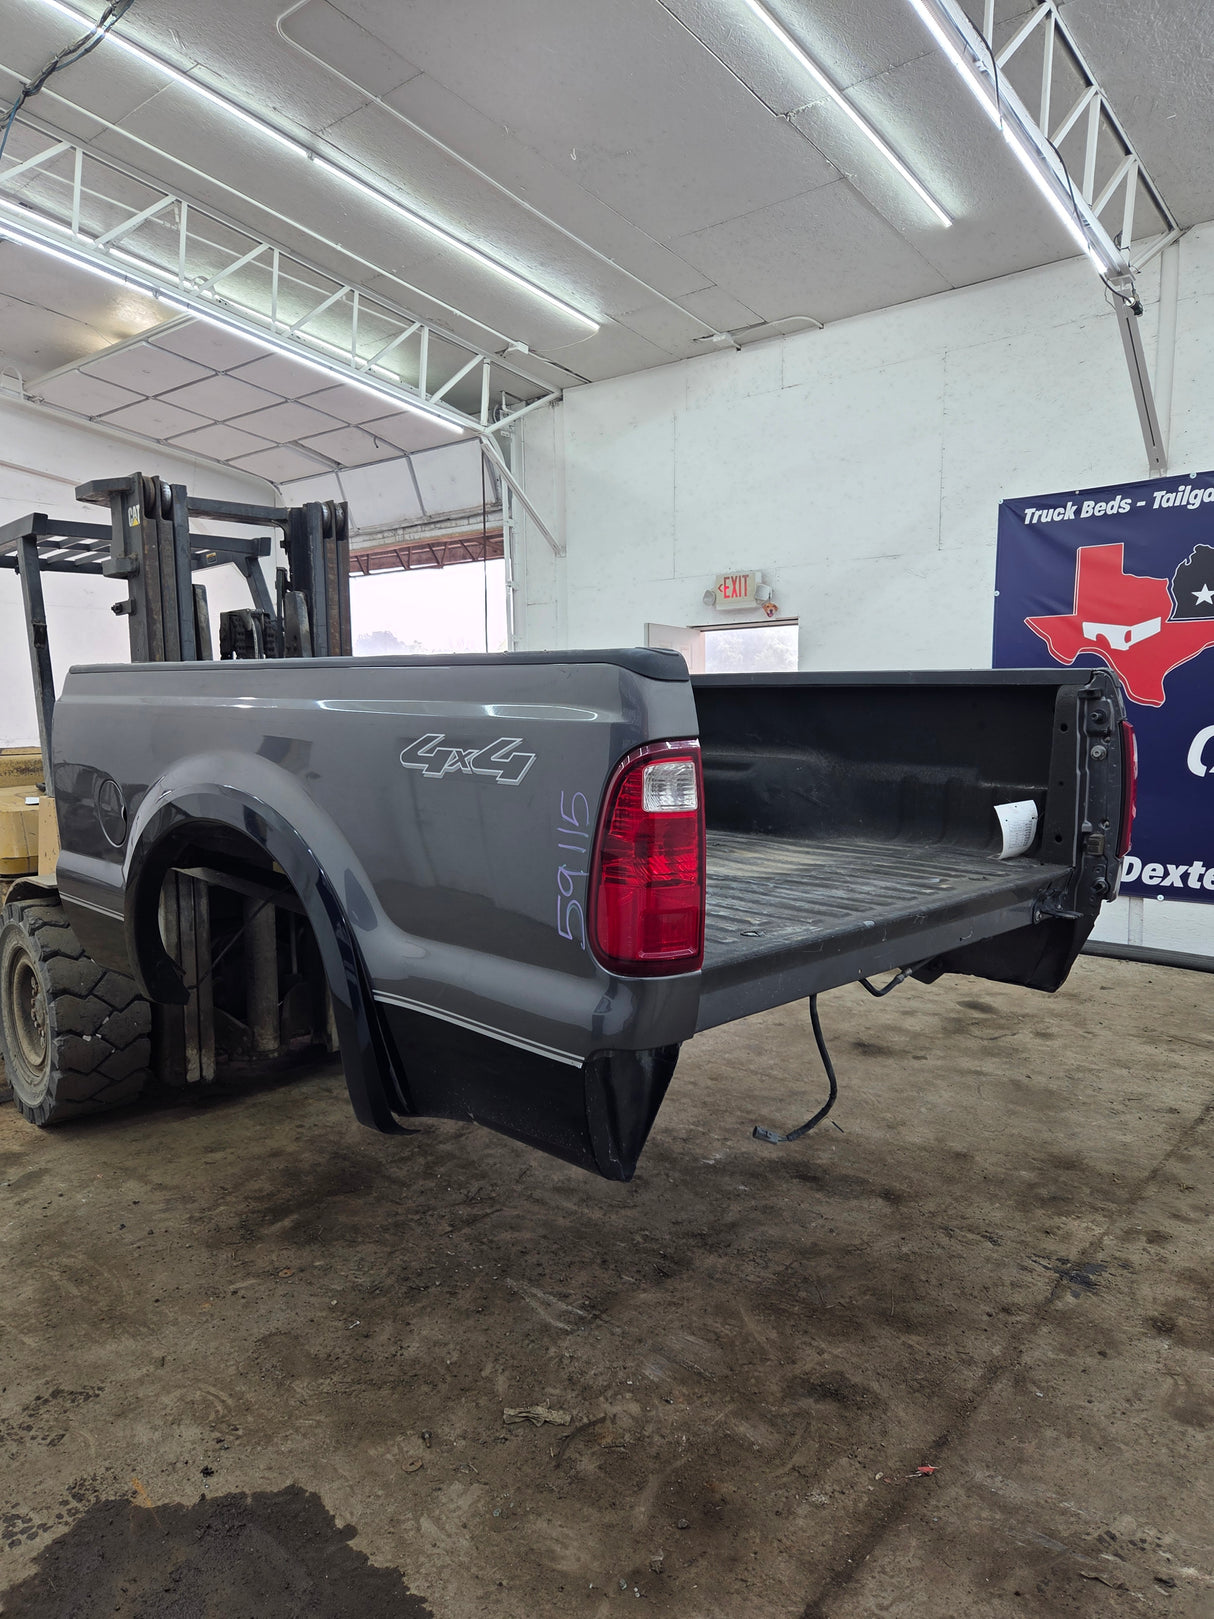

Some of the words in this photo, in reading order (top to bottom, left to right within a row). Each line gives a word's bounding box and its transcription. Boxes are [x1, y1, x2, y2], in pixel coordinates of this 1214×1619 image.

[127, 504, 140, 527] CAT
[1024, 501, 1078, 525] Truck
[1080, 495, 1132, 518] Beds
[1152, 485, 1214, 510] Tailga
[723, 574, 750, 599] EXIT
[400, 733, 537, 786] 4x4
[557, 790, 590, 950] 59115
